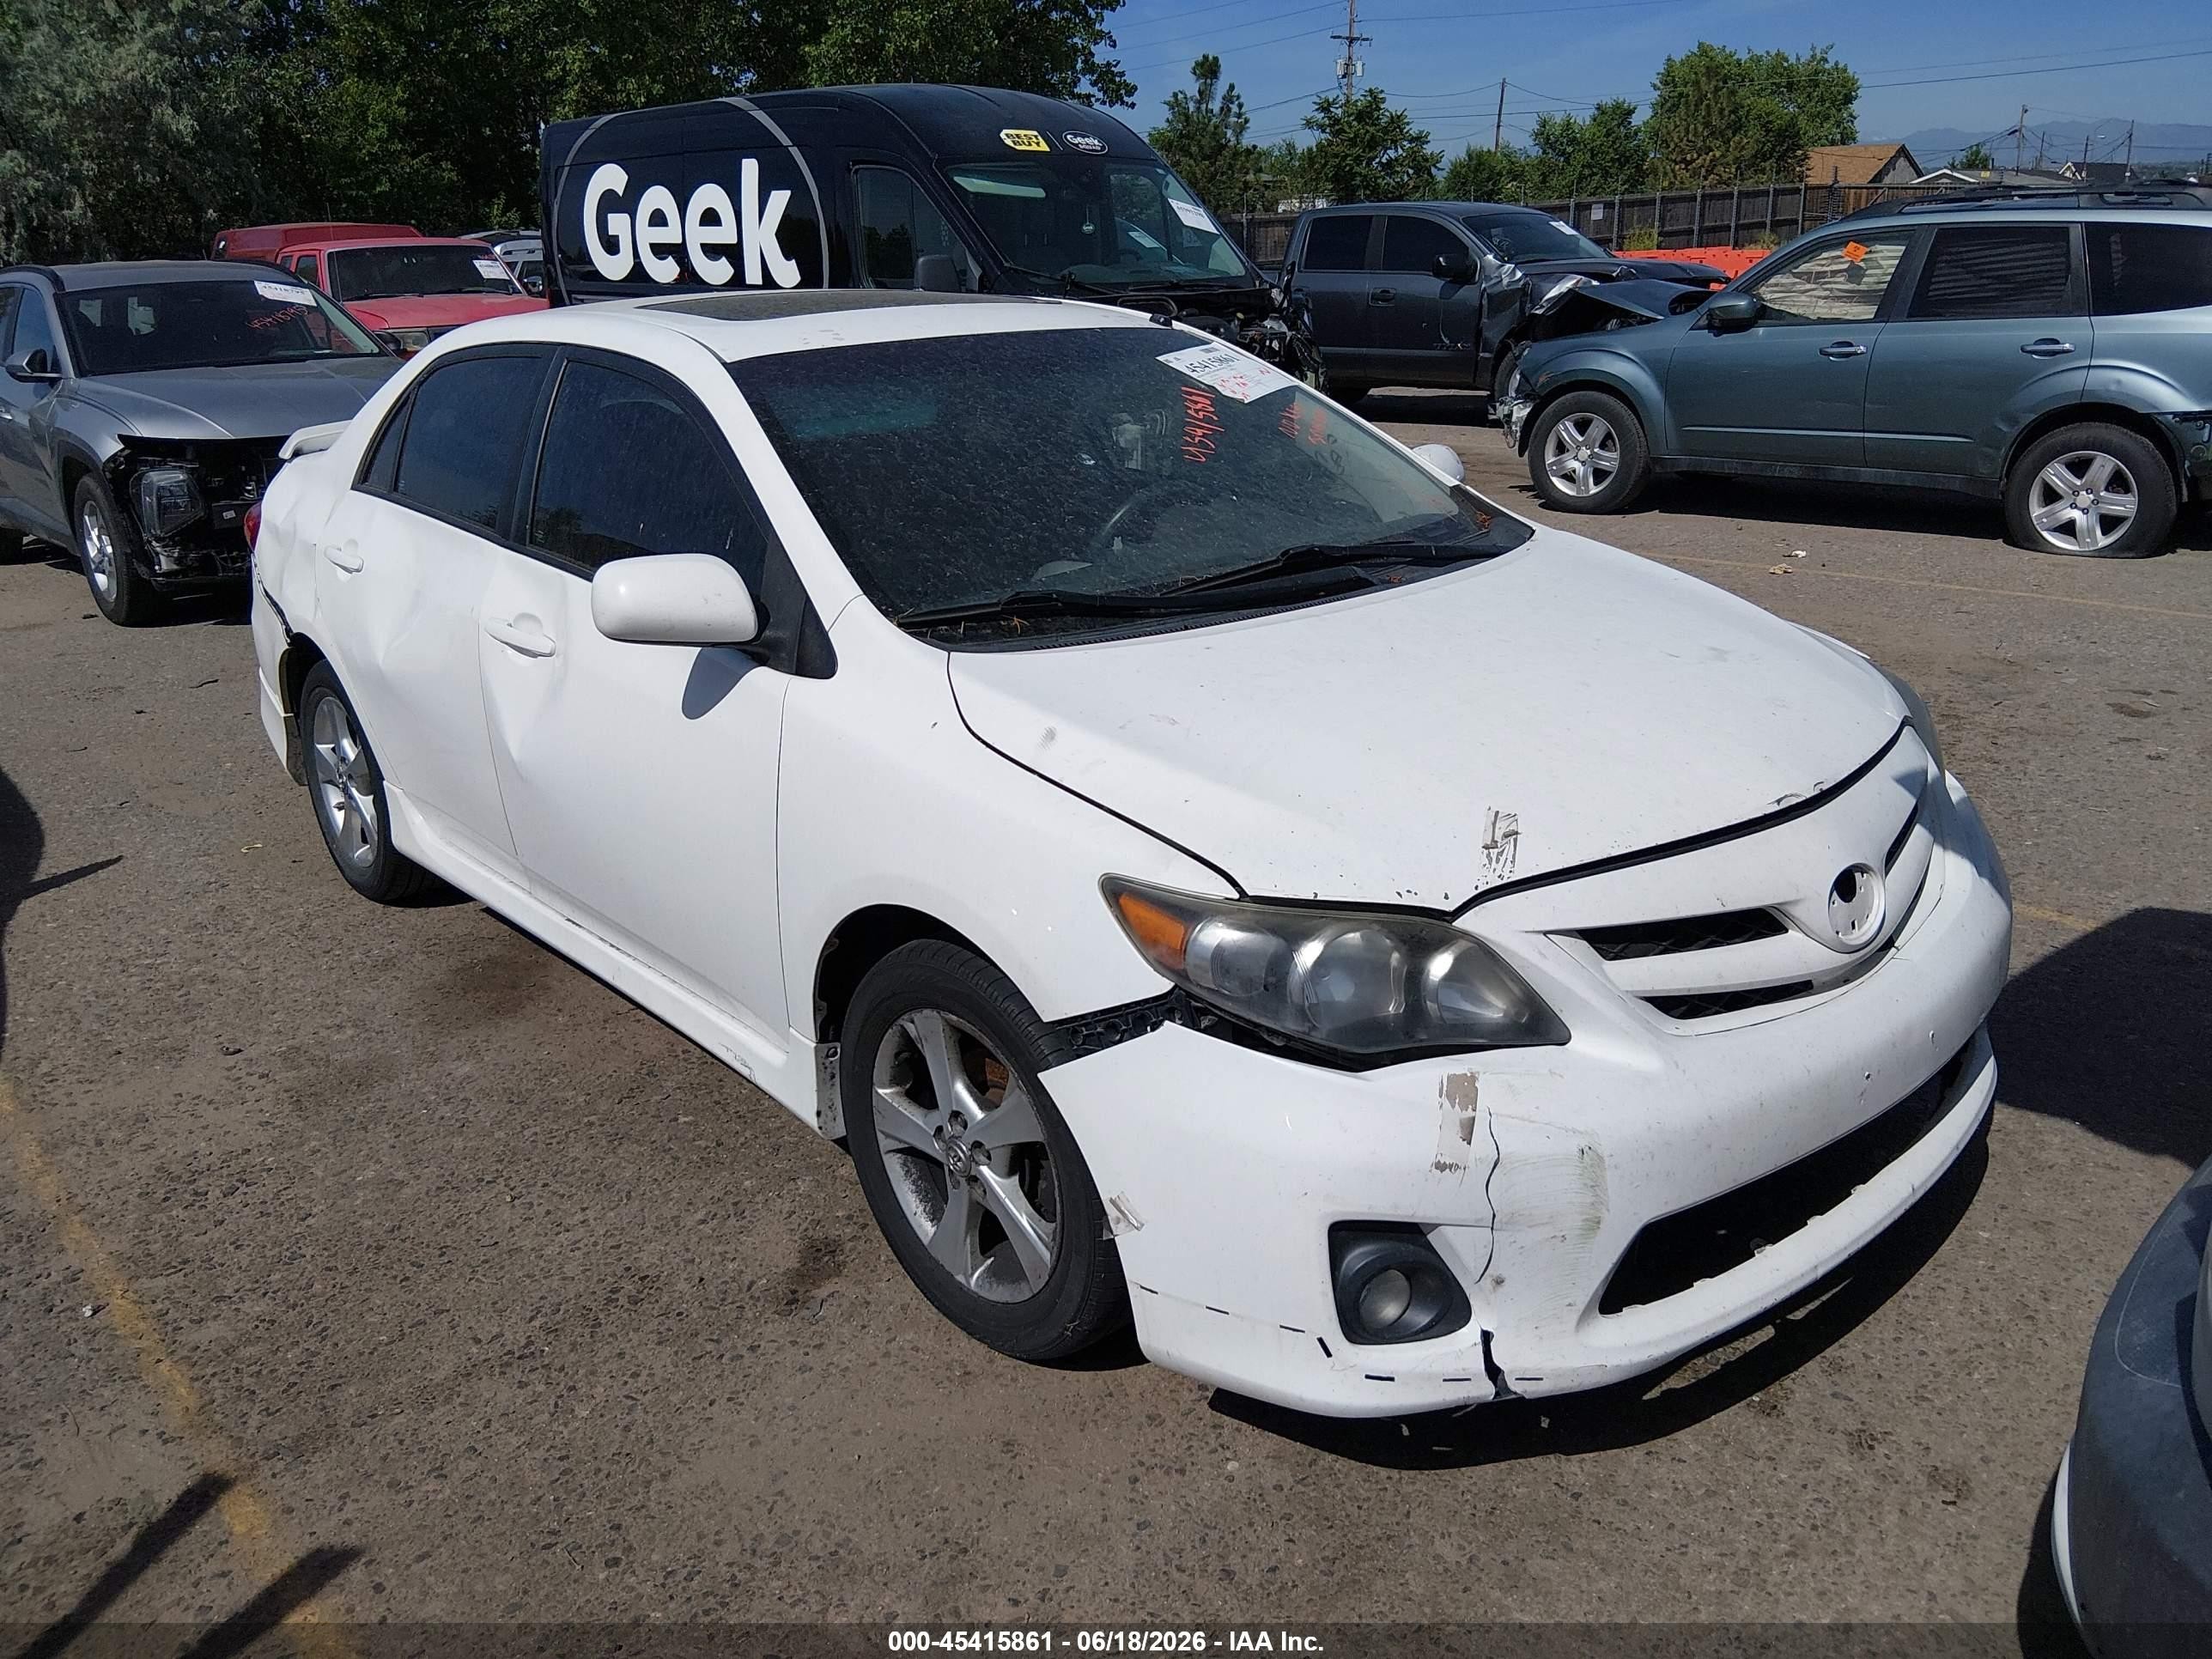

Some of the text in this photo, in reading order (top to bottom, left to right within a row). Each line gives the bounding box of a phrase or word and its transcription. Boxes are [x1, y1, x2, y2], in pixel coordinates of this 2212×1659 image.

[1004, 132, 1040, 141] BEST
[1066, 134, 1103, 146] Geek
[583, 158, 801, 289] Geek
[1183, 353, 1241, 374] 45415861
